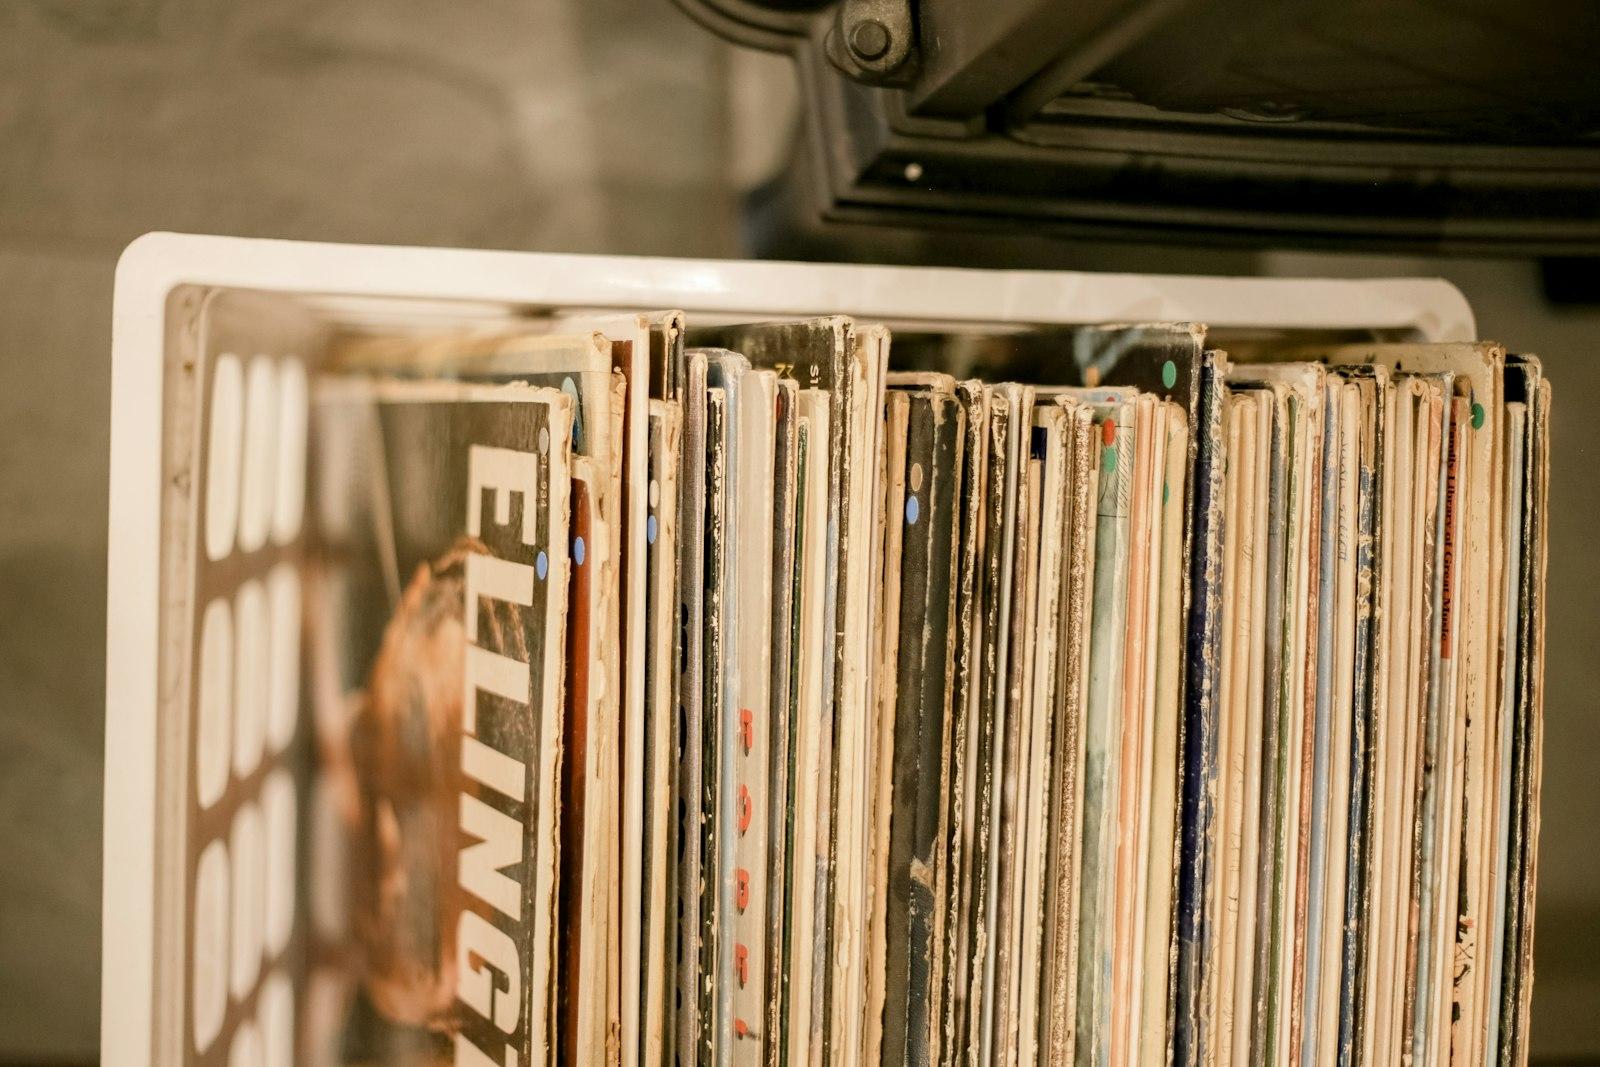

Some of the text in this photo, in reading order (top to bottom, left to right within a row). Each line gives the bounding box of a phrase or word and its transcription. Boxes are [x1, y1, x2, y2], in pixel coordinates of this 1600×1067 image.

[1441, 422, 1456, 641] Family Library of Great Music
